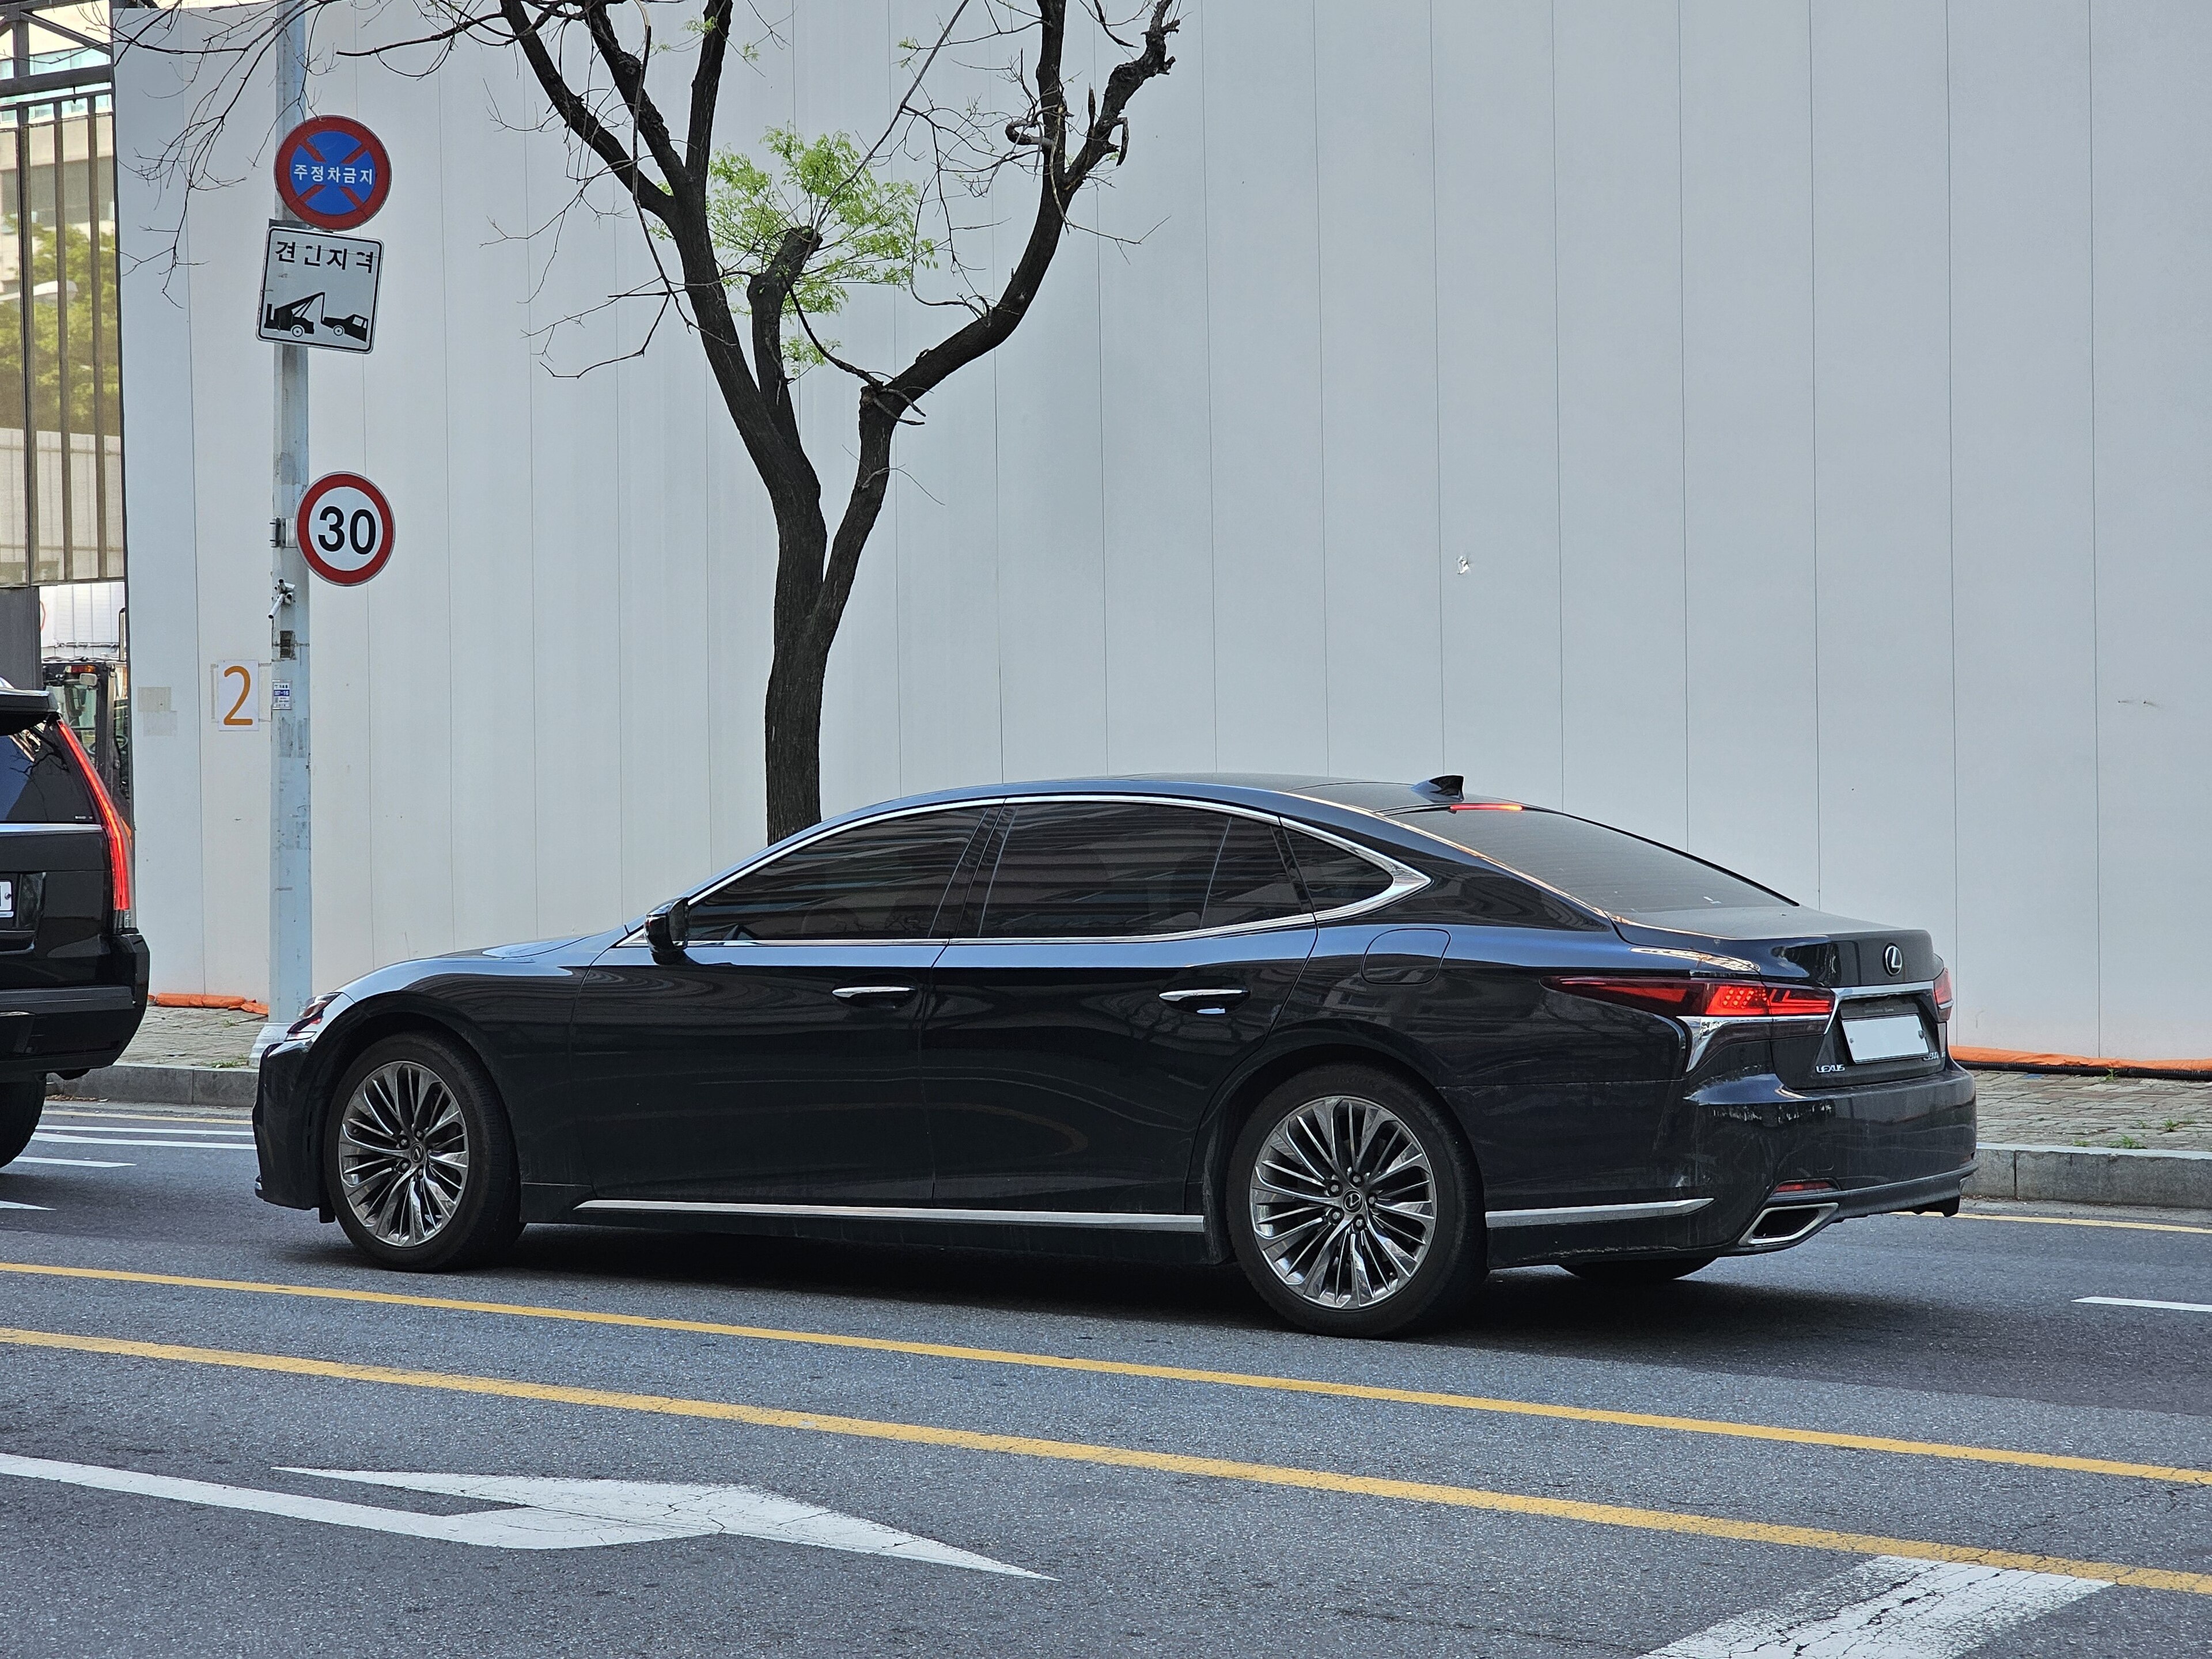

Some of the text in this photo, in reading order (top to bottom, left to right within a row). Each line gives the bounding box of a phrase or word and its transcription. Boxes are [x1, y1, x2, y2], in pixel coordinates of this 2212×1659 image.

[294, 164, 373, 185] 주정차금지
[274, 241, 374, 274] 견인지역
[318, 506, 376, 555] 30
[224, 665, 253, 726] 2
[1816, 1065, 1845, 1073] LEXUS
